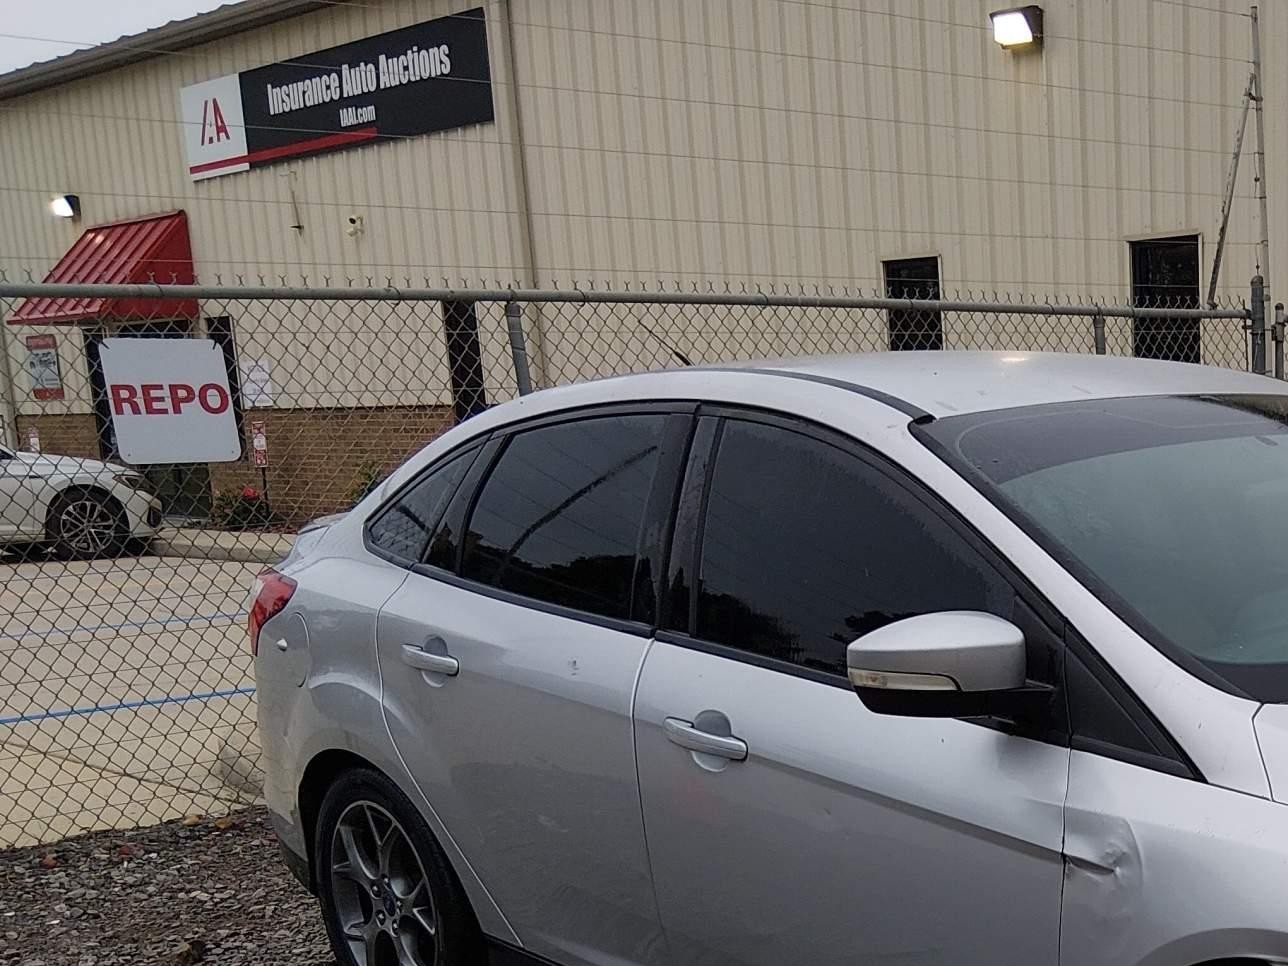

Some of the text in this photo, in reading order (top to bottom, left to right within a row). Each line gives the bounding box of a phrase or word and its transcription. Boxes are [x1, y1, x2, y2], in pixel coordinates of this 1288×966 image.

[267, 44, 451, 116] Insurance Auto Auctions
[109, 382, 229, 416] REPO
